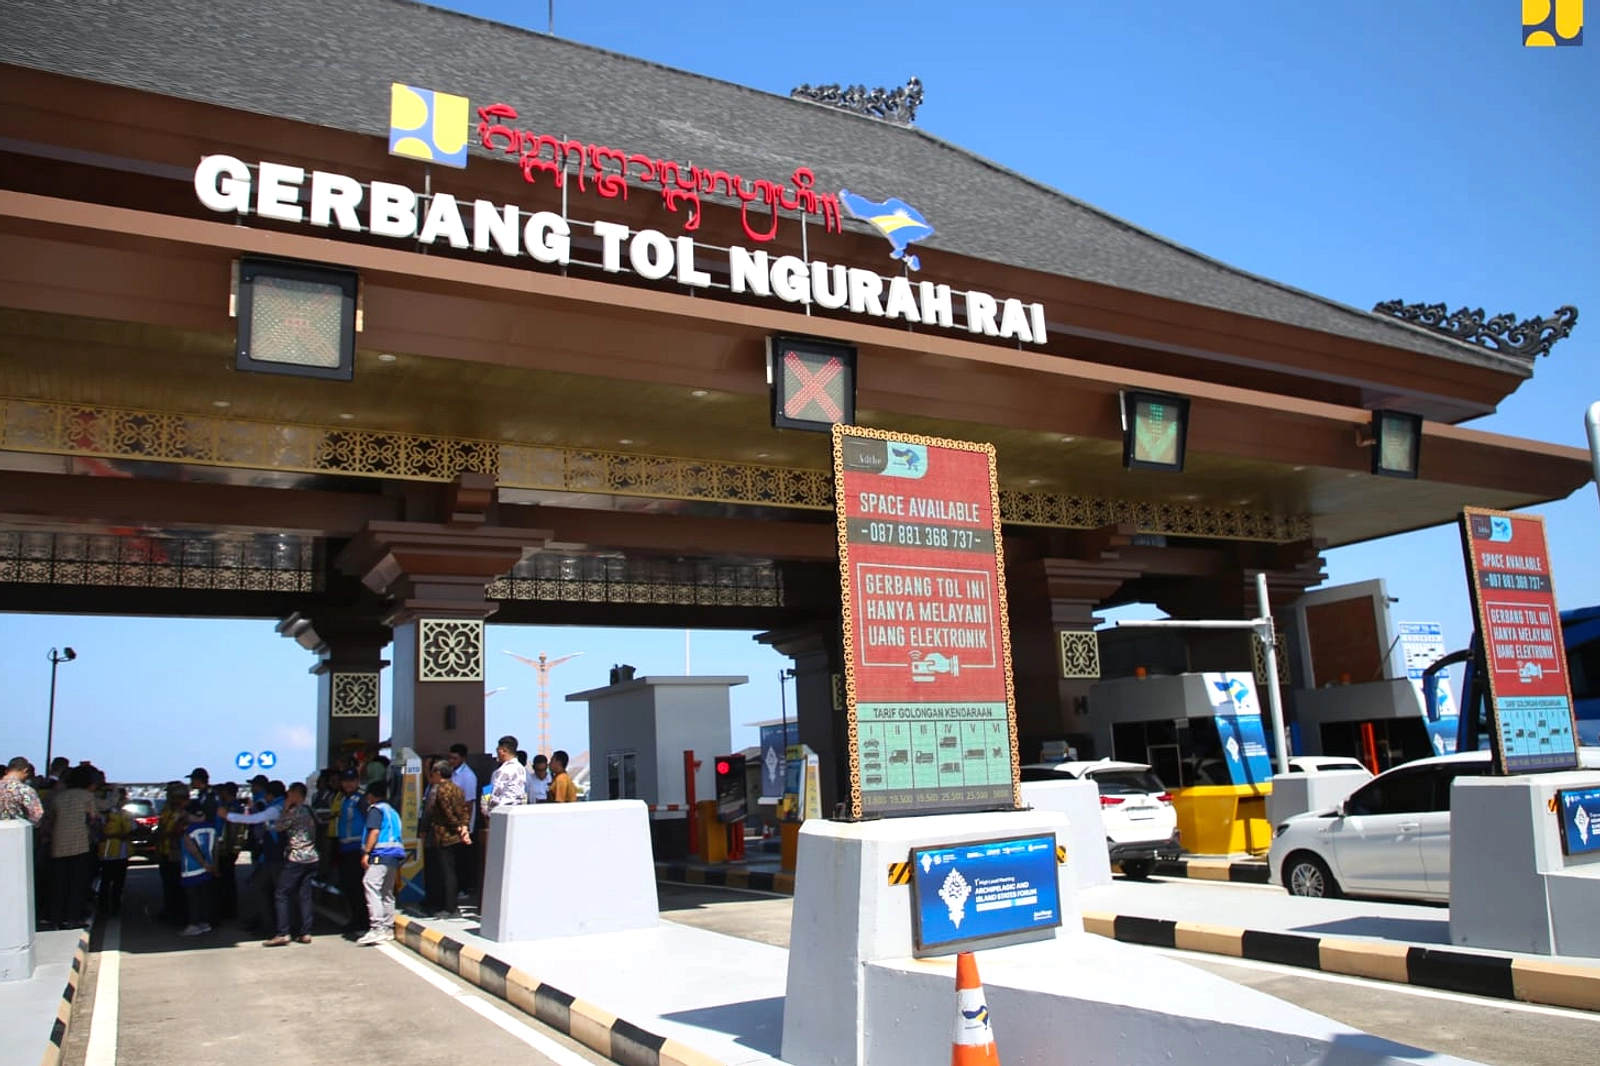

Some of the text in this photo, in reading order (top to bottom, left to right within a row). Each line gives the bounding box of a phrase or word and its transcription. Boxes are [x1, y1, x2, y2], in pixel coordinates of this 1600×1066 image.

[194, 154, 571, 265] GERBANG
[594, 221, 711, 287] TOL
[730, 245, 954, 328] NGURAH
[966, 291, 1048, 344] RAI
[860, 492, 980, 522] SPACE AVAILABLE
[898, 525, 921, 545] 881
[925, 528, 948, 547] 368
[1482, 553, 1542, 571] SPACE AVAILABLE
[865, 574, 985, 599] GERBANG TOL INI
[867, 600, 987, 624] HANYA MELAYANI
[868, 625, 988, 649] UANG ELEKTRONIK
[874, 707, 992, 719] TARIF GOLONGAN KENDARAAN
[944, 724, 952, 734] IV
[970, 723, 976, 733] V
[993, 723, 1000, 733] VI
